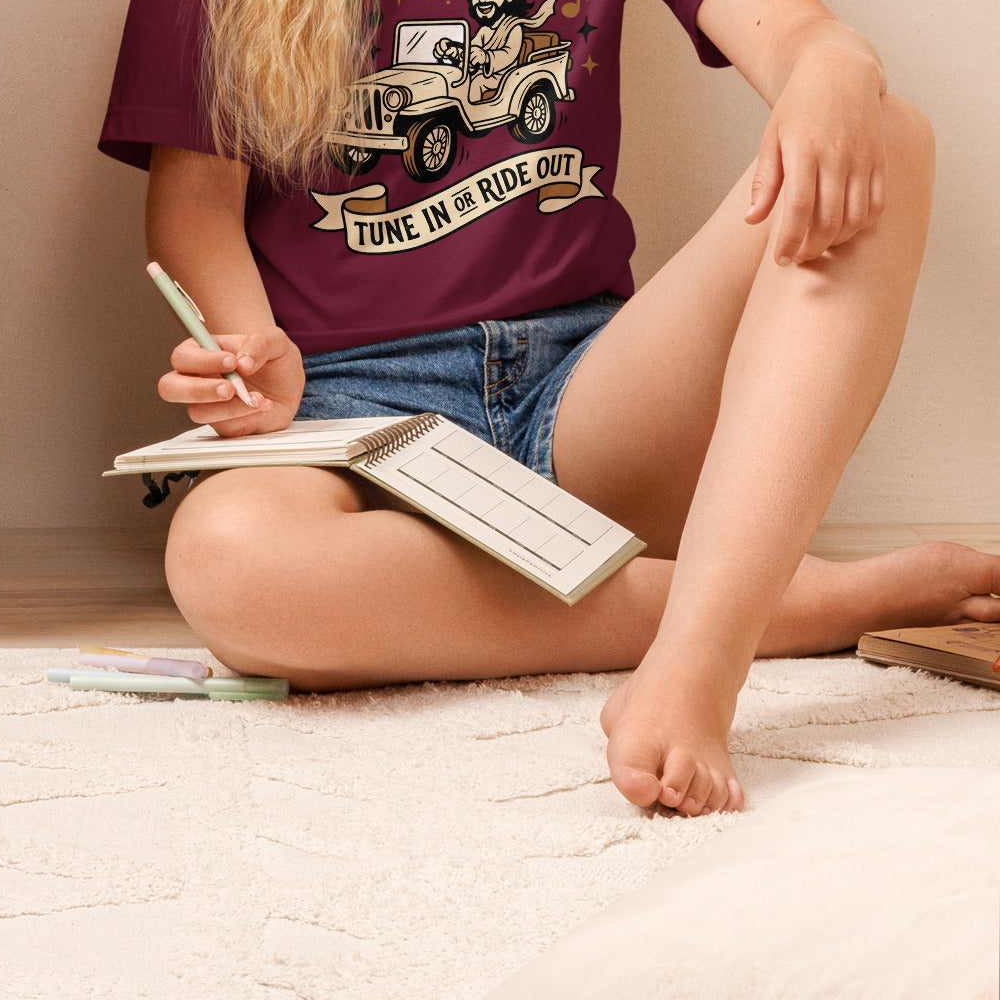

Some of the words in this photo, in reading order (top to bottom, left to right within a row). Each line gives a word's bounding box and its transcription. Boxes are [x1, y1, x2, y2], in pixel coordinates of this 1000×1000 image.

[354, 213, 421, 246] TUNE
[421, 200, 452, 233] IN
[454, 191, 477, 212] OR
[477, 161, 532, 204] RIDE
[536, 153, 576, 180] OUT
